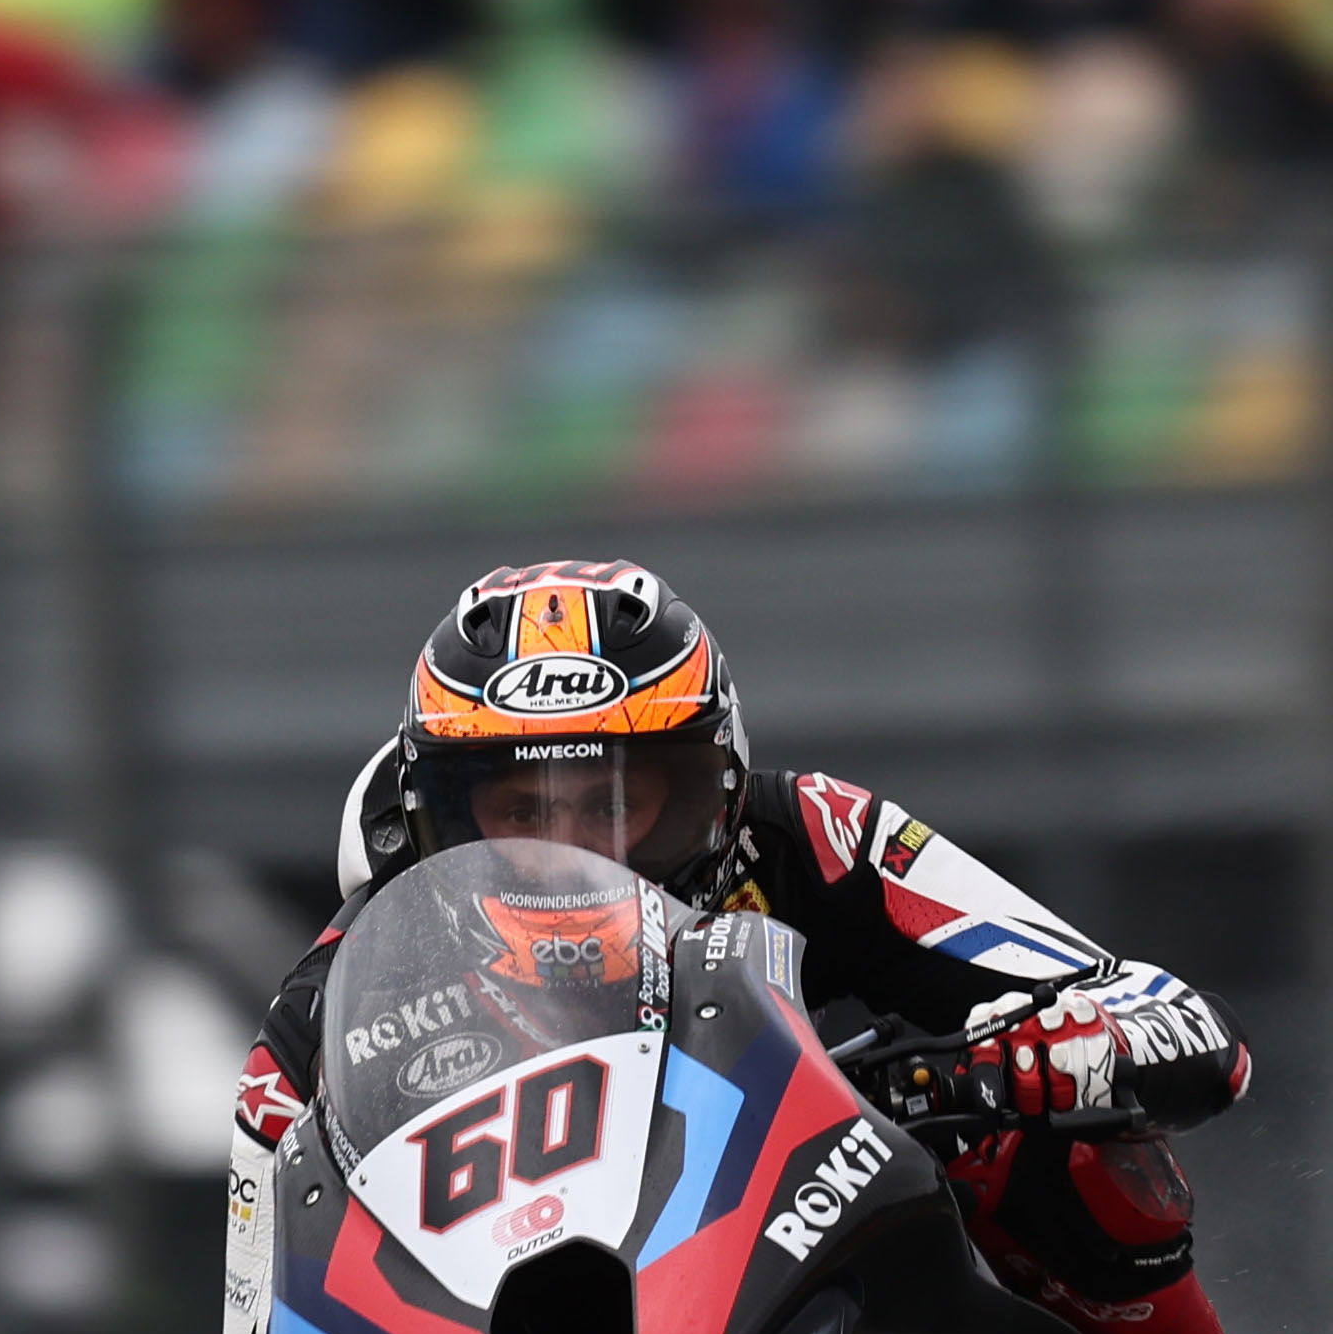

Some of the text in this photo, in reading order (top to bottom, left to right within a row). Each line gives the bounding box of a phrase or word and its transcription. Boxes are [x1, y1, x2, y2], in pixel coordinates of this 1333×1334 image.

[495, 664, 609, 704] Arai
[529, 697, 582, 708] HELMET
[515, 742, 604, 761] HAVECON
[532, 931, 603, 965] ebc
[345, 983, 473, 1067] ROKiT
[965, 1018, 1006, 1043] domino
[404, 1053, 611, 1235] 60
[764, 1117, 894, 1263] ROKiT
[507, 1226, 563, 1261] OUTDO
